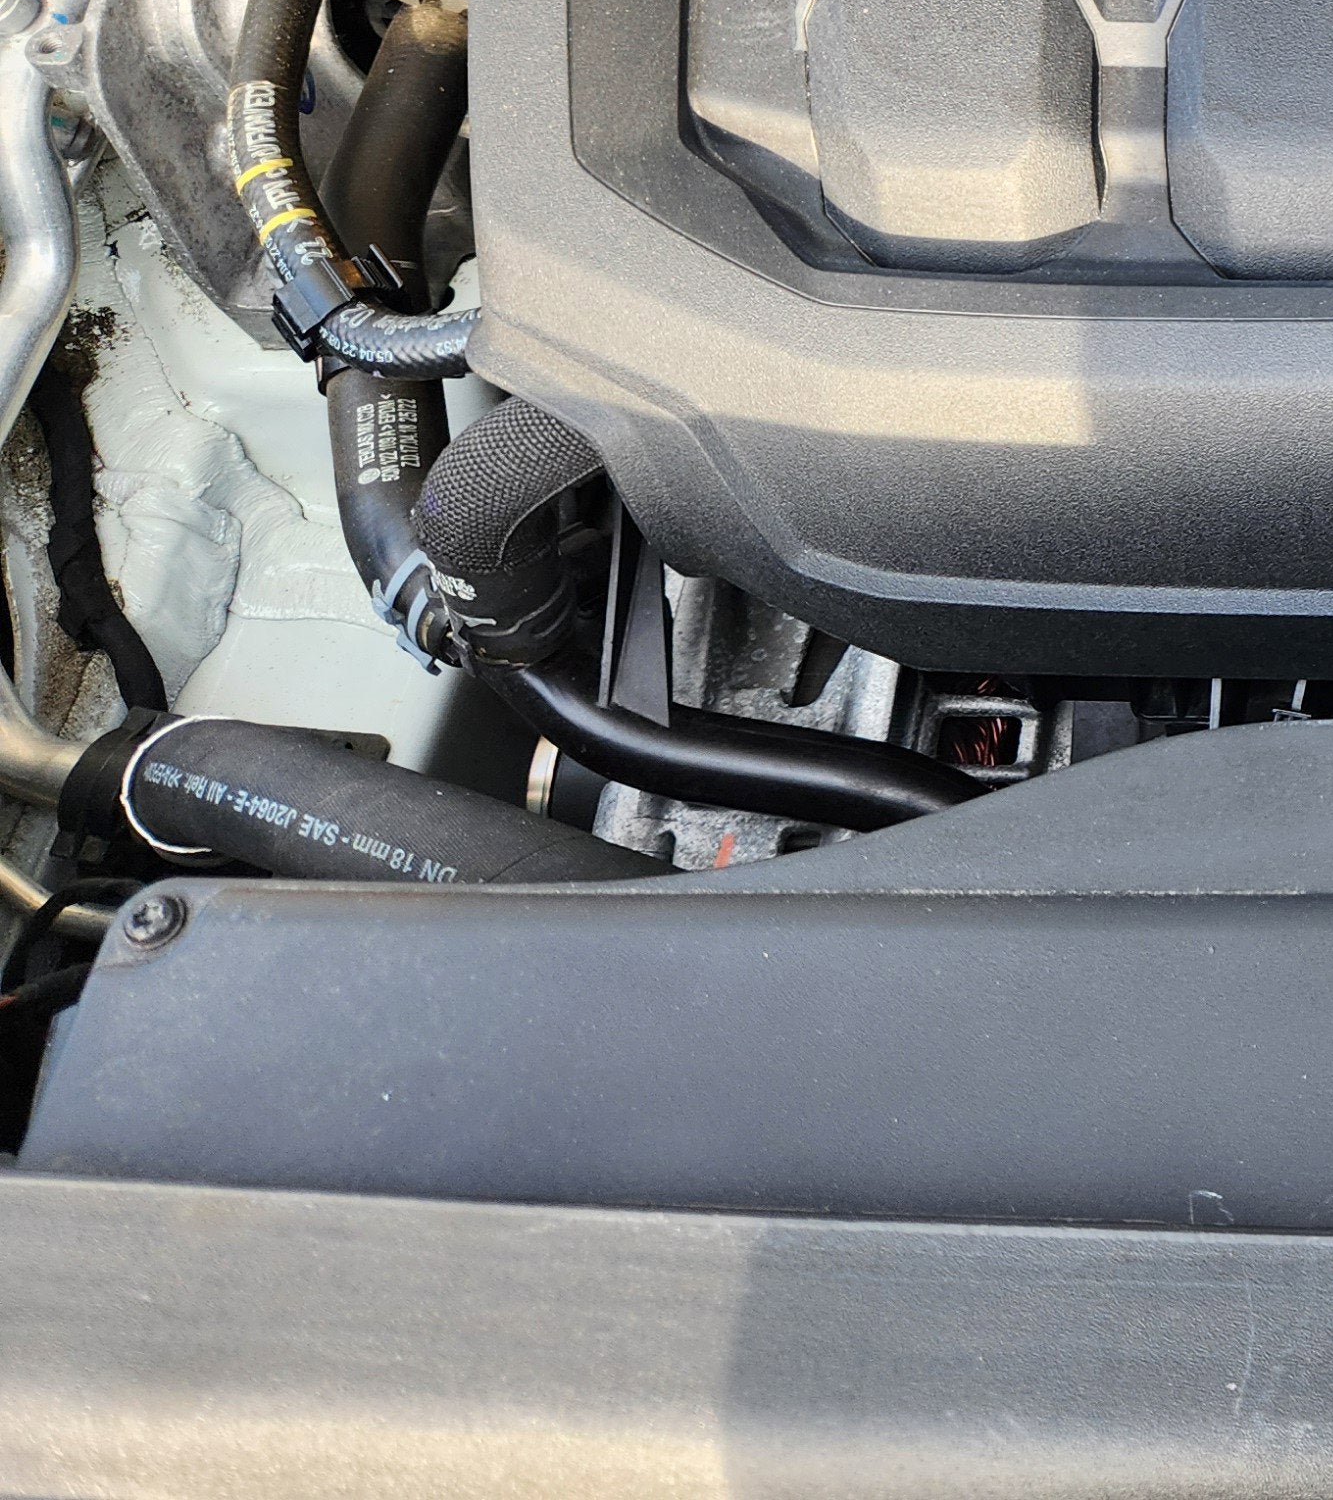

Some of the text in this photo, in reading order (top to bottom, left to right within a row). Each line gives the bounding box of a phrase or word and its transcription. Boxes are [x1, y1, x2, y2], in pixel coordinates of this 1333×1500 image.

[234, 790, 297, 829] J2064-E
[298, 815, 340, 846] SAE
[418, 858, 457, 884] DN
